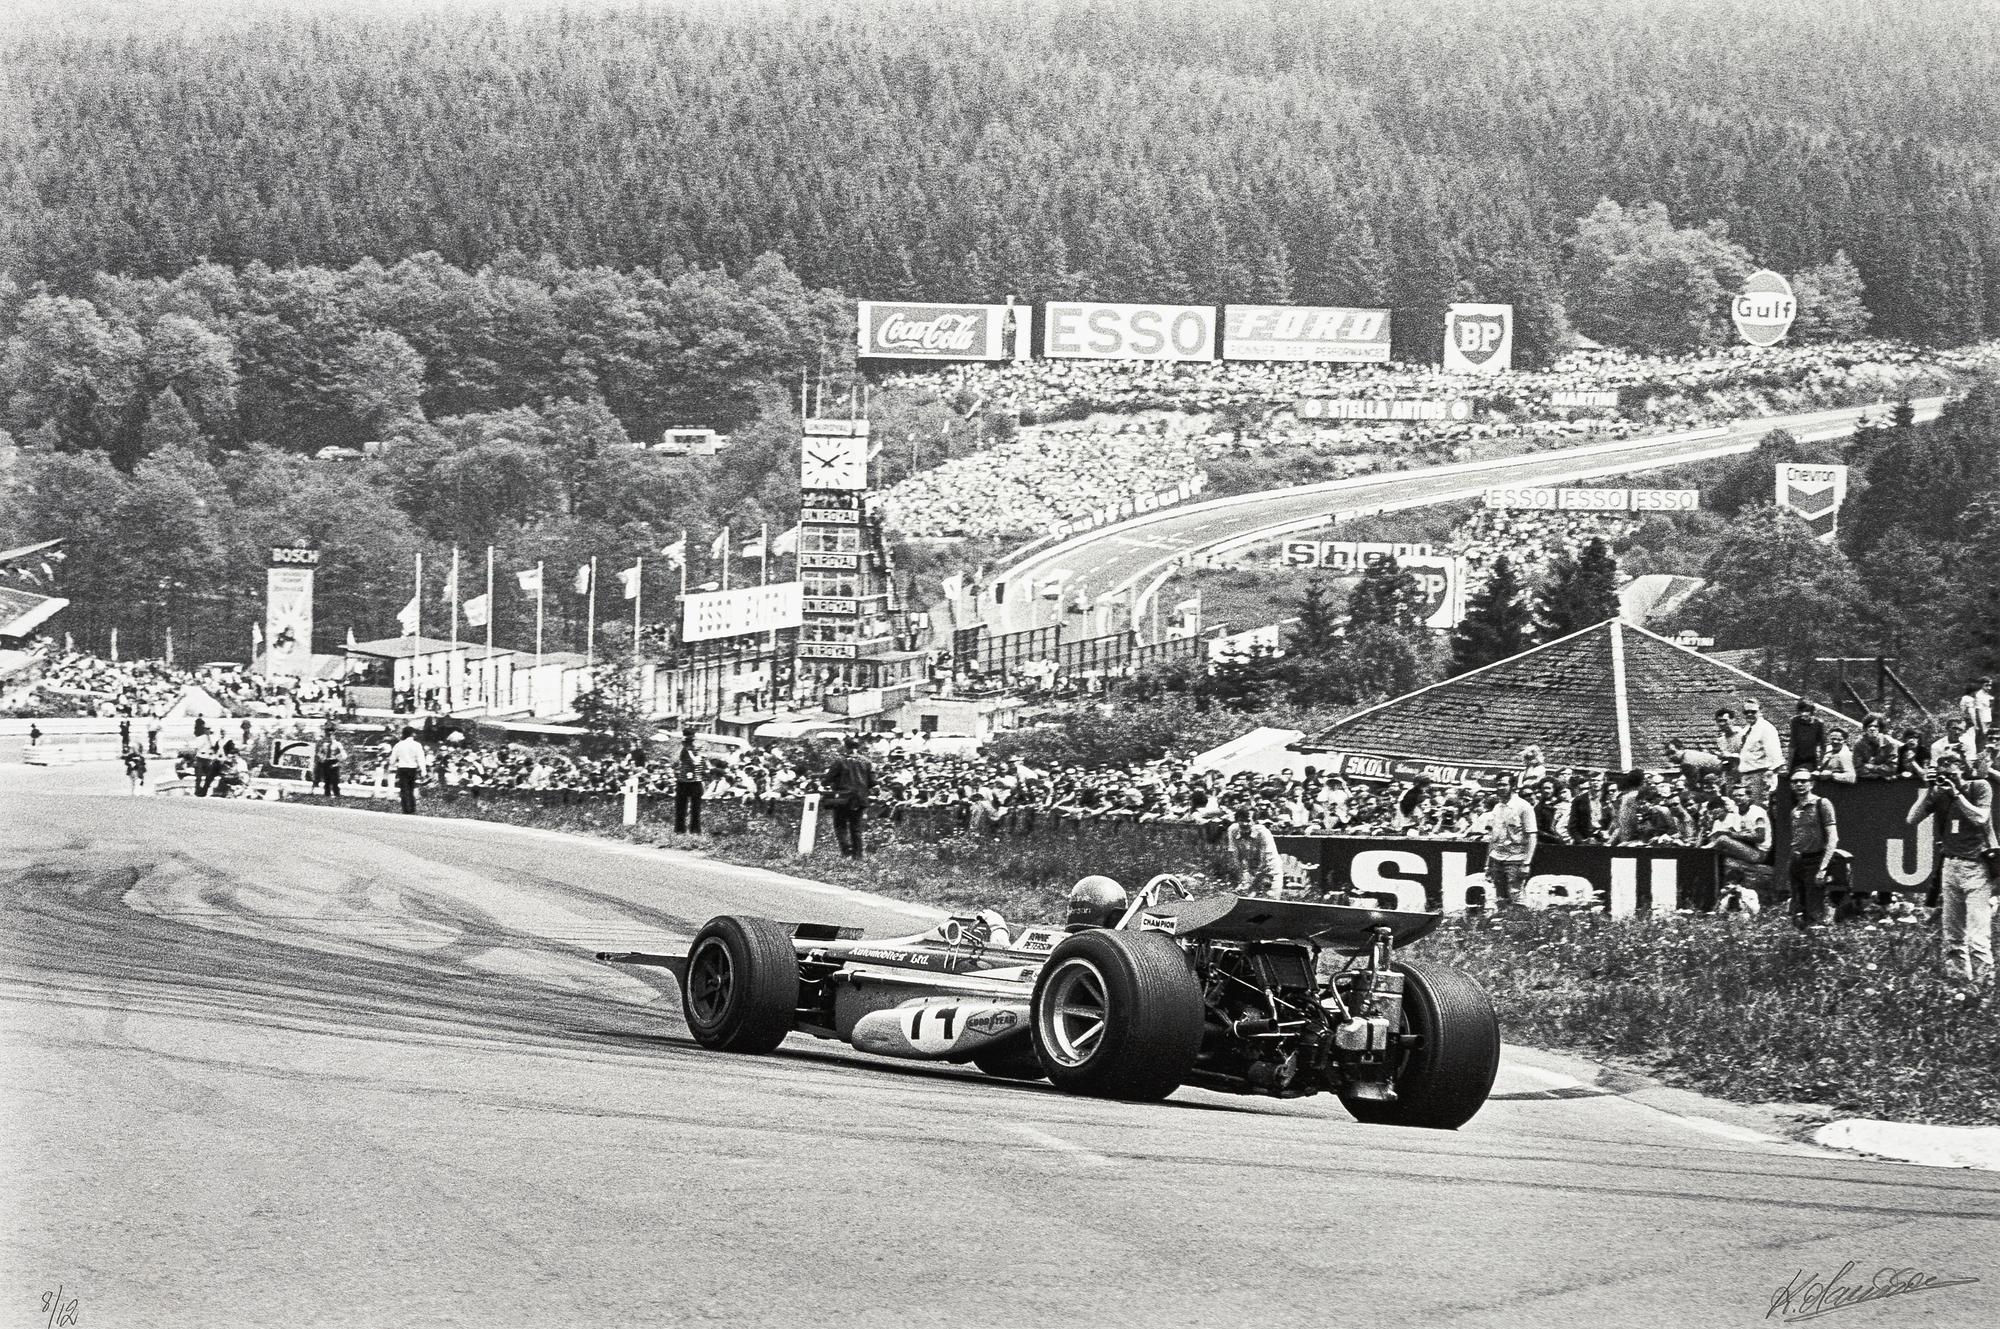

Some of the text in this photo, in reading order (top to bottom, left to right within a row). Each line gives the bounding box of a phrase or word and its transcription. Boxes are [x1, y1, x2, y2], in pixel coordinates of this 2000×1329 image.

[1737, 297, 1792, 318] Gulf
[876, 312, 979, 350] Coca-Cola
[1050, 307, 1207, 356] ESSO
[1236, 309, 1386, 341] FORD
[1459, 321, 1501, 352] BP
[1787, 467, 1837, 482] Chevron
[1490, 489, 1694, 509] ESSO ESSO ESSO
[272, 547, 319, 563] BOSCH
[1350, 849, 1678, 919] Shell
[1142, 918, 1175, 930] CHAMPION
[910, 953, 930, 965] Ltd.
